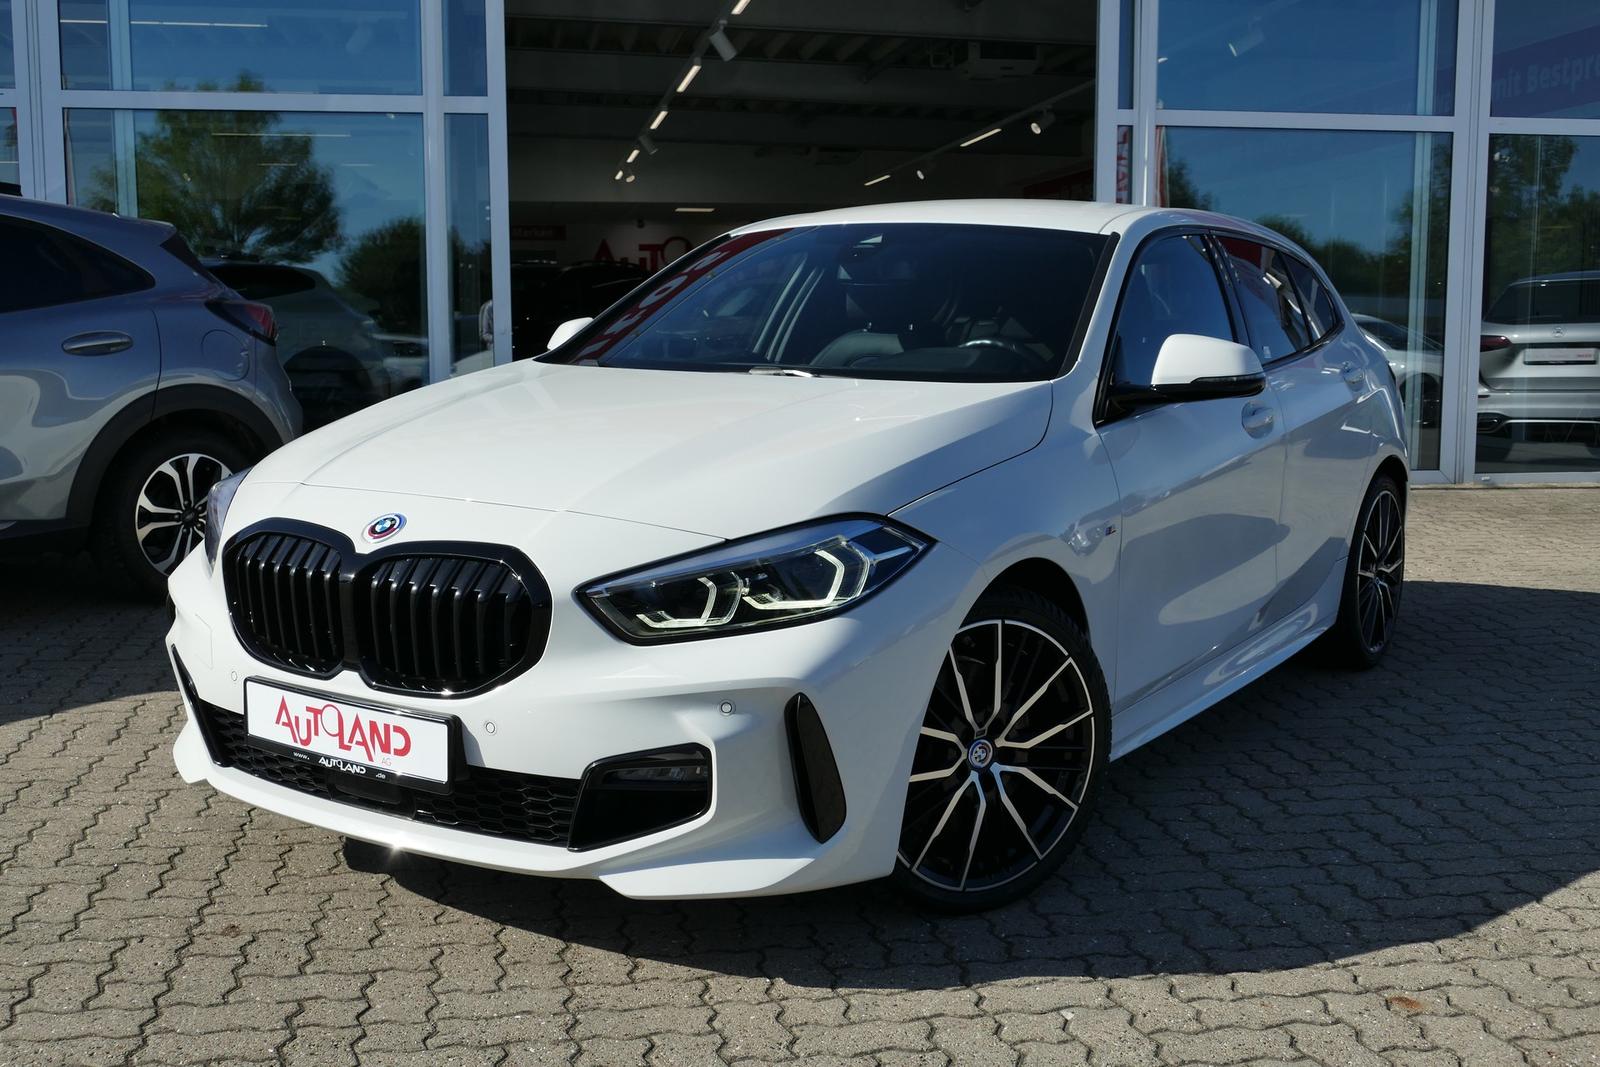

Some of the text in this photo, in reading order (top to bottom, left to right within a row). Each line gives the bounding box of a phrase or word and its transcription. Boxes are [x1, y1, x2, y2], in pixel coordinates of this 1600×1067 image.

[275, 696, 411, 762] AUTOLAND
[293, 752, 310, 760] www.
[318, 756, 366, 774] AUTOLAND
